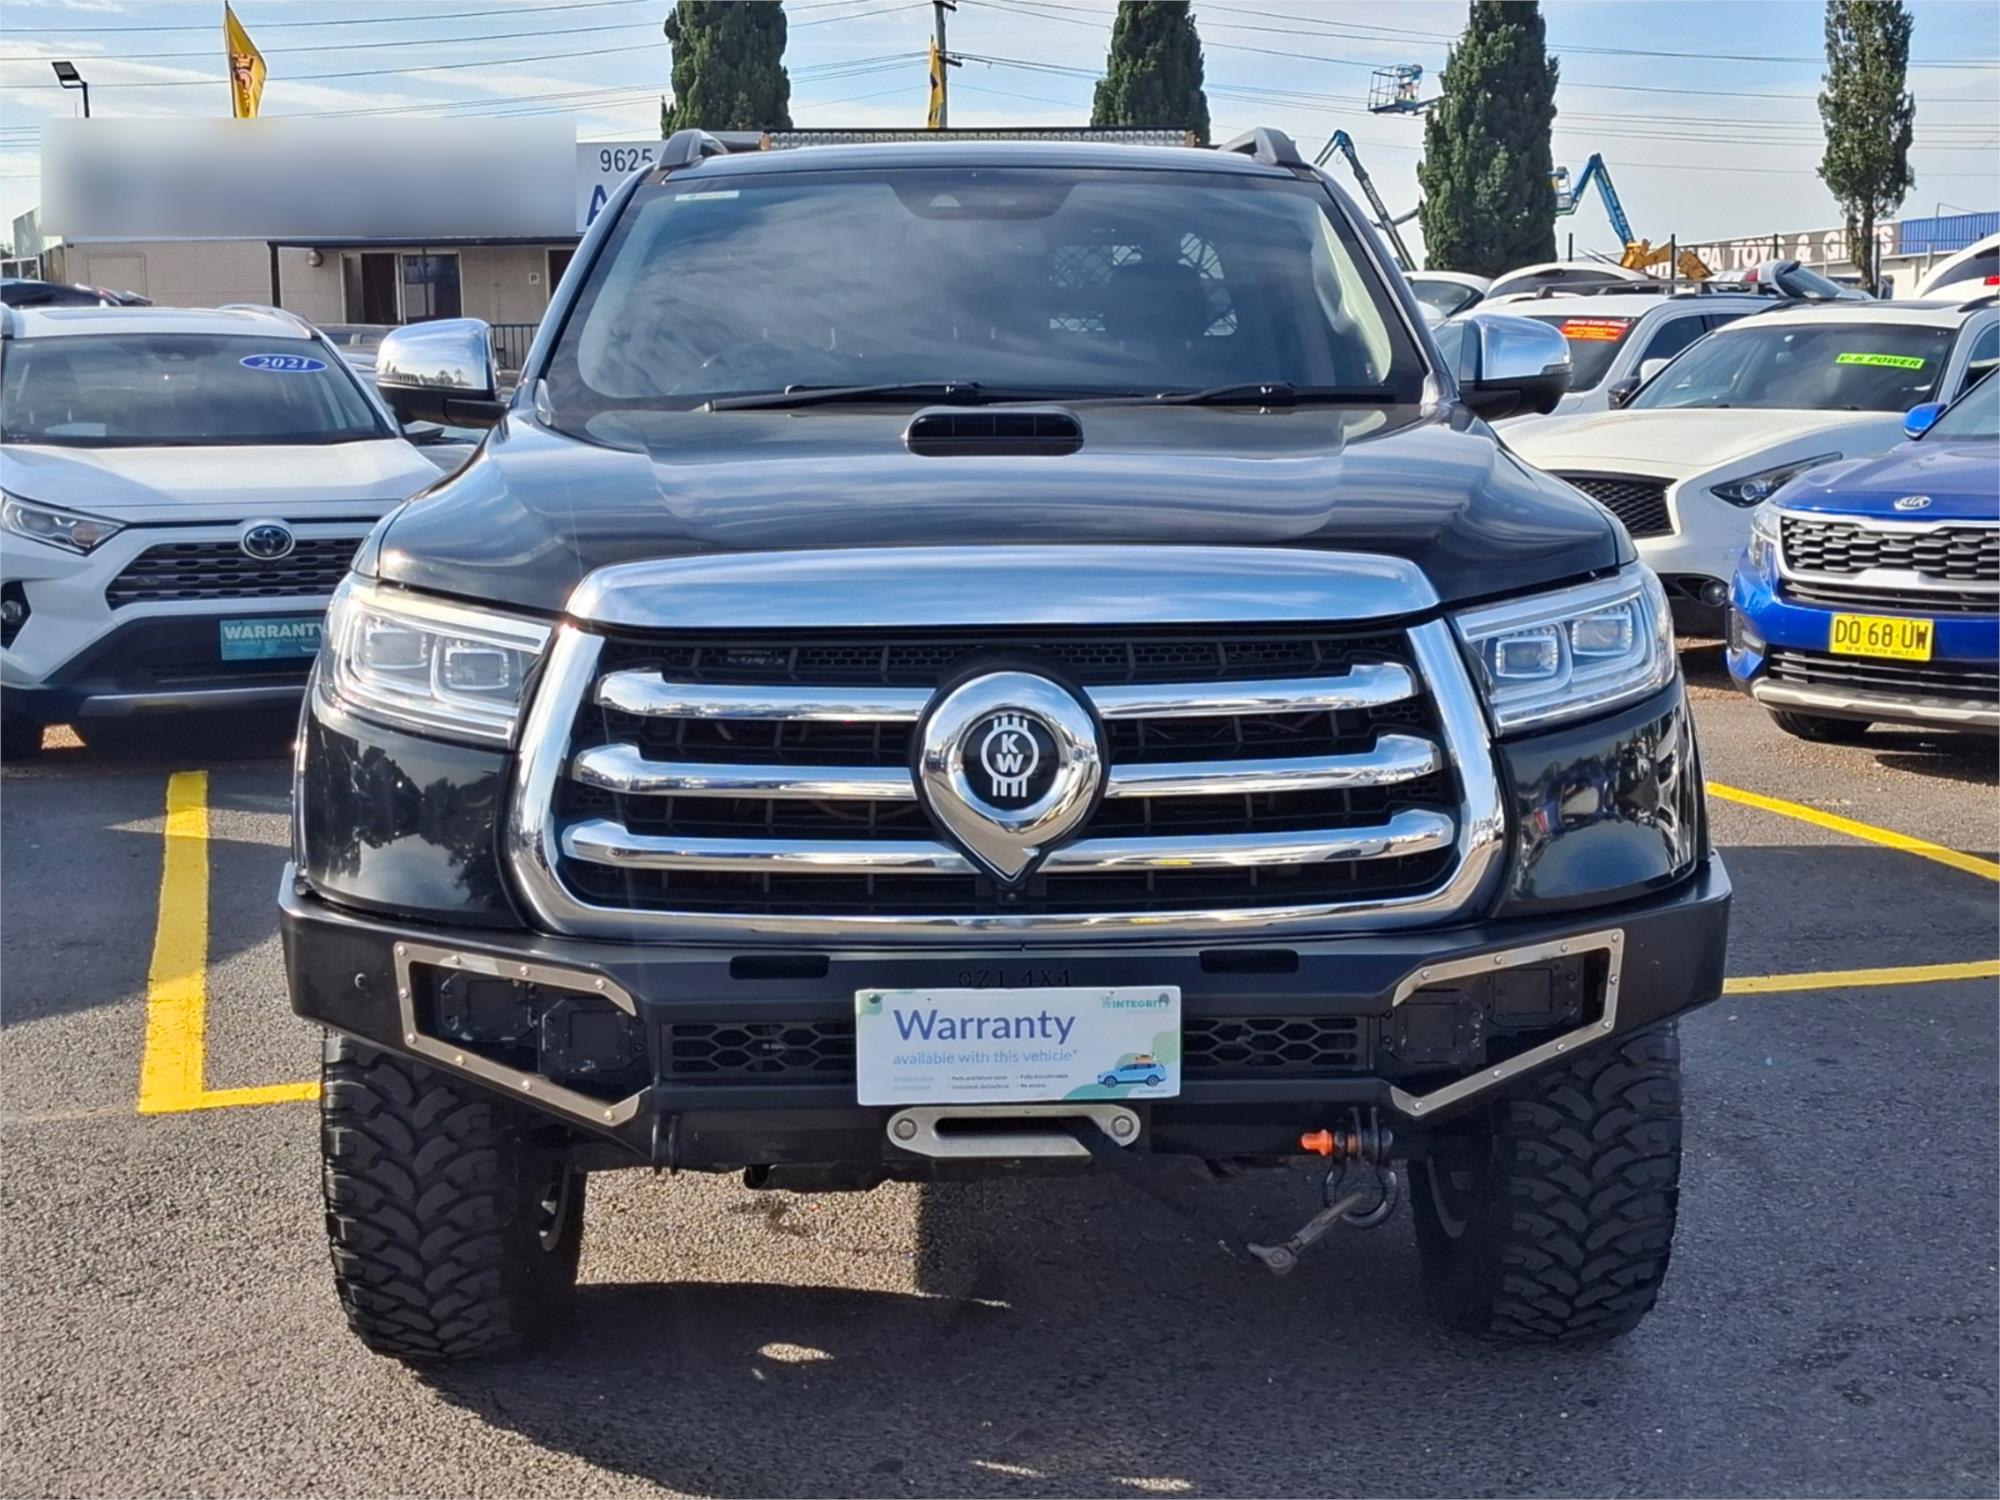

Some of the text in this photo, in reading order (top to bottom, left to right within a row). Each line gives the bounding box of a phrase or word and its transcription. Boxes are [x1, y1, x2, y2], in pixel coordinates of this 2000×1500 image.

[600, 148, 653, 172] 9625
[1795, 234, 1812, 262] &
[258, 357, 310, 369] 2021
[1867, 356, 1921, 367] POWER
[893, 1009, 1076, 1045] Warranty
[893, 1052, 955, 1065] available
[958, 1051, 990, 1064] with
[993, 1050, 1019, 1063] this
